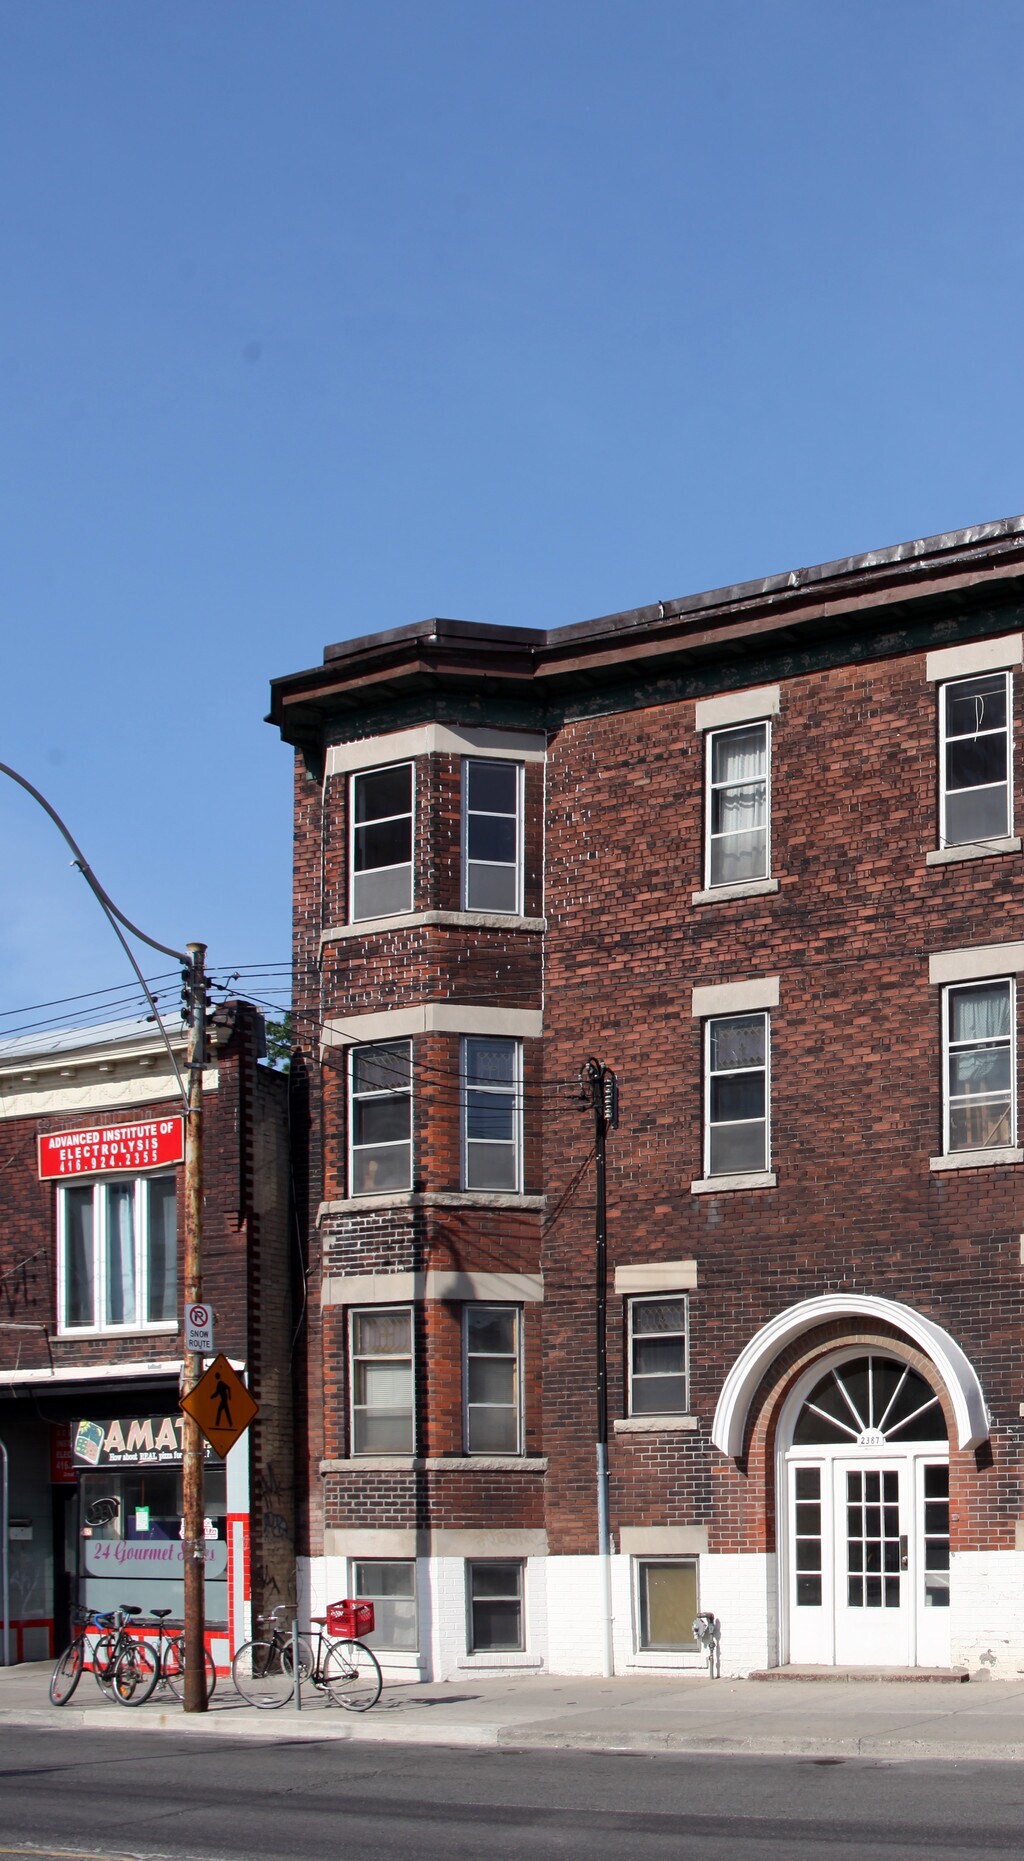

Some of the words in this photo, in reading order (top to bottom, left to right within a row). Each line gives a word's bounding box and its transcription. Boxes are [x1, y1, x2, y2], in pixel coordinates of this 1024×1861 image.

[48, 1132, 100, 1149] ADVANCED
[103, 1124, 158, 1142] INSTITUTE
[160, 1121, 174, 1135] OF
[59, 1137, 158, 1161] ELECTROLYSIS
[59, 1150, 158, 1172] 416.924.2355
[189, 1329, 209, 1338] SNOW
[188, 1339, 211, 1348] ROUTE
[860, 1436, 880, 1445] 2387
[109, 1453, 122, 1461] How
[122, 1452, 138, 1461] about
[139, 1452, 158, 1461] REAL
[158, 1451, 173, 1462] pizza
[173, 1451, 183, 1459] for
[93, 1542, 111, 1560] 24
[114, 1540, 174, 1565] Gourmet
